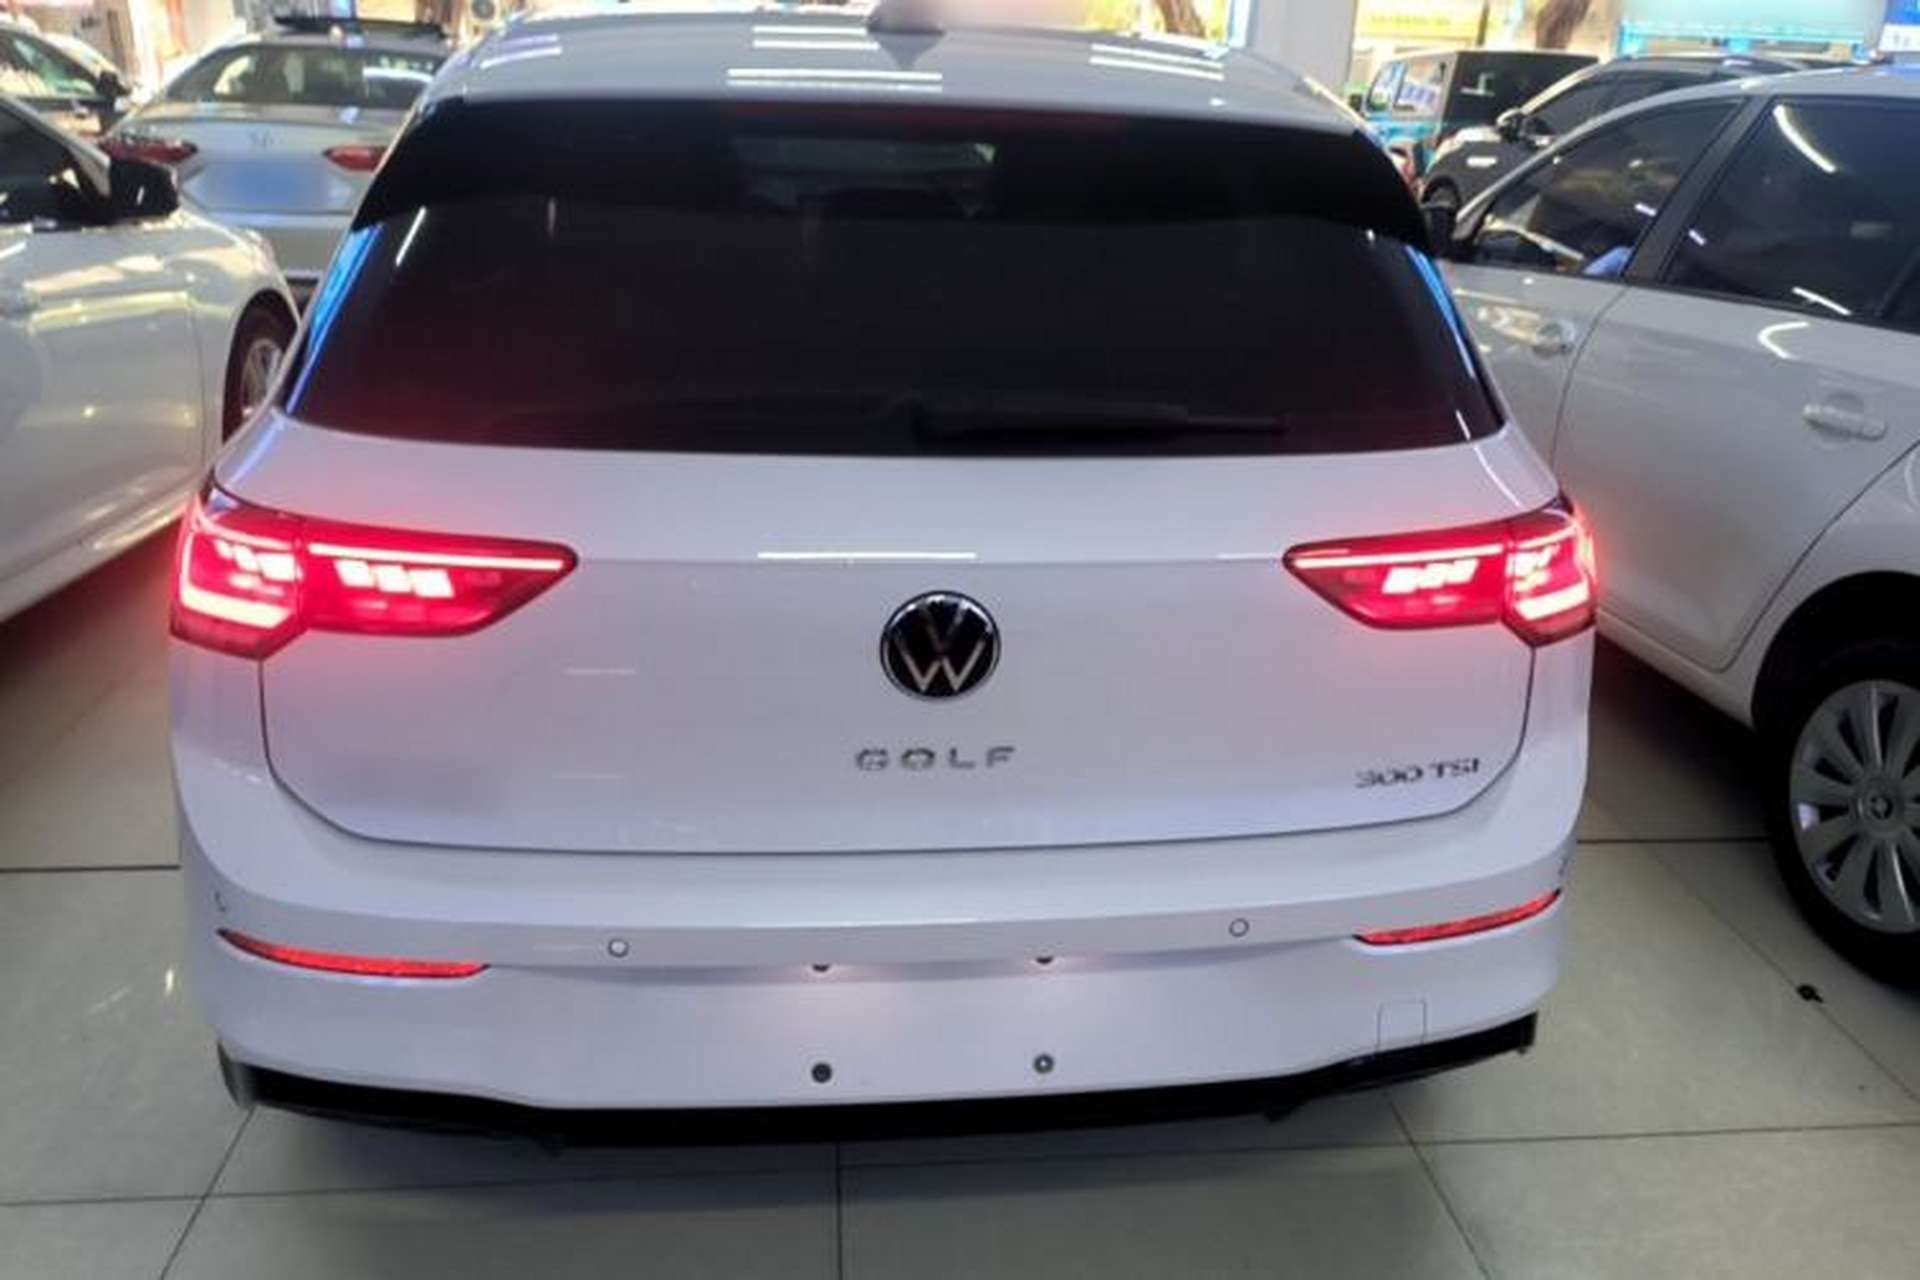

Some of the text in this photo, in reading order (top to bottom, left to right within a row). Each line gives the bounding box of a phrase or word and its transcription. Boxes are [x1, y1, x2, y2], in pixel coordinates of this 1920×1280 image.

[855, 745, 1017, 772] GOLF
[1355, 757, 1480, 788] 300 TSI
